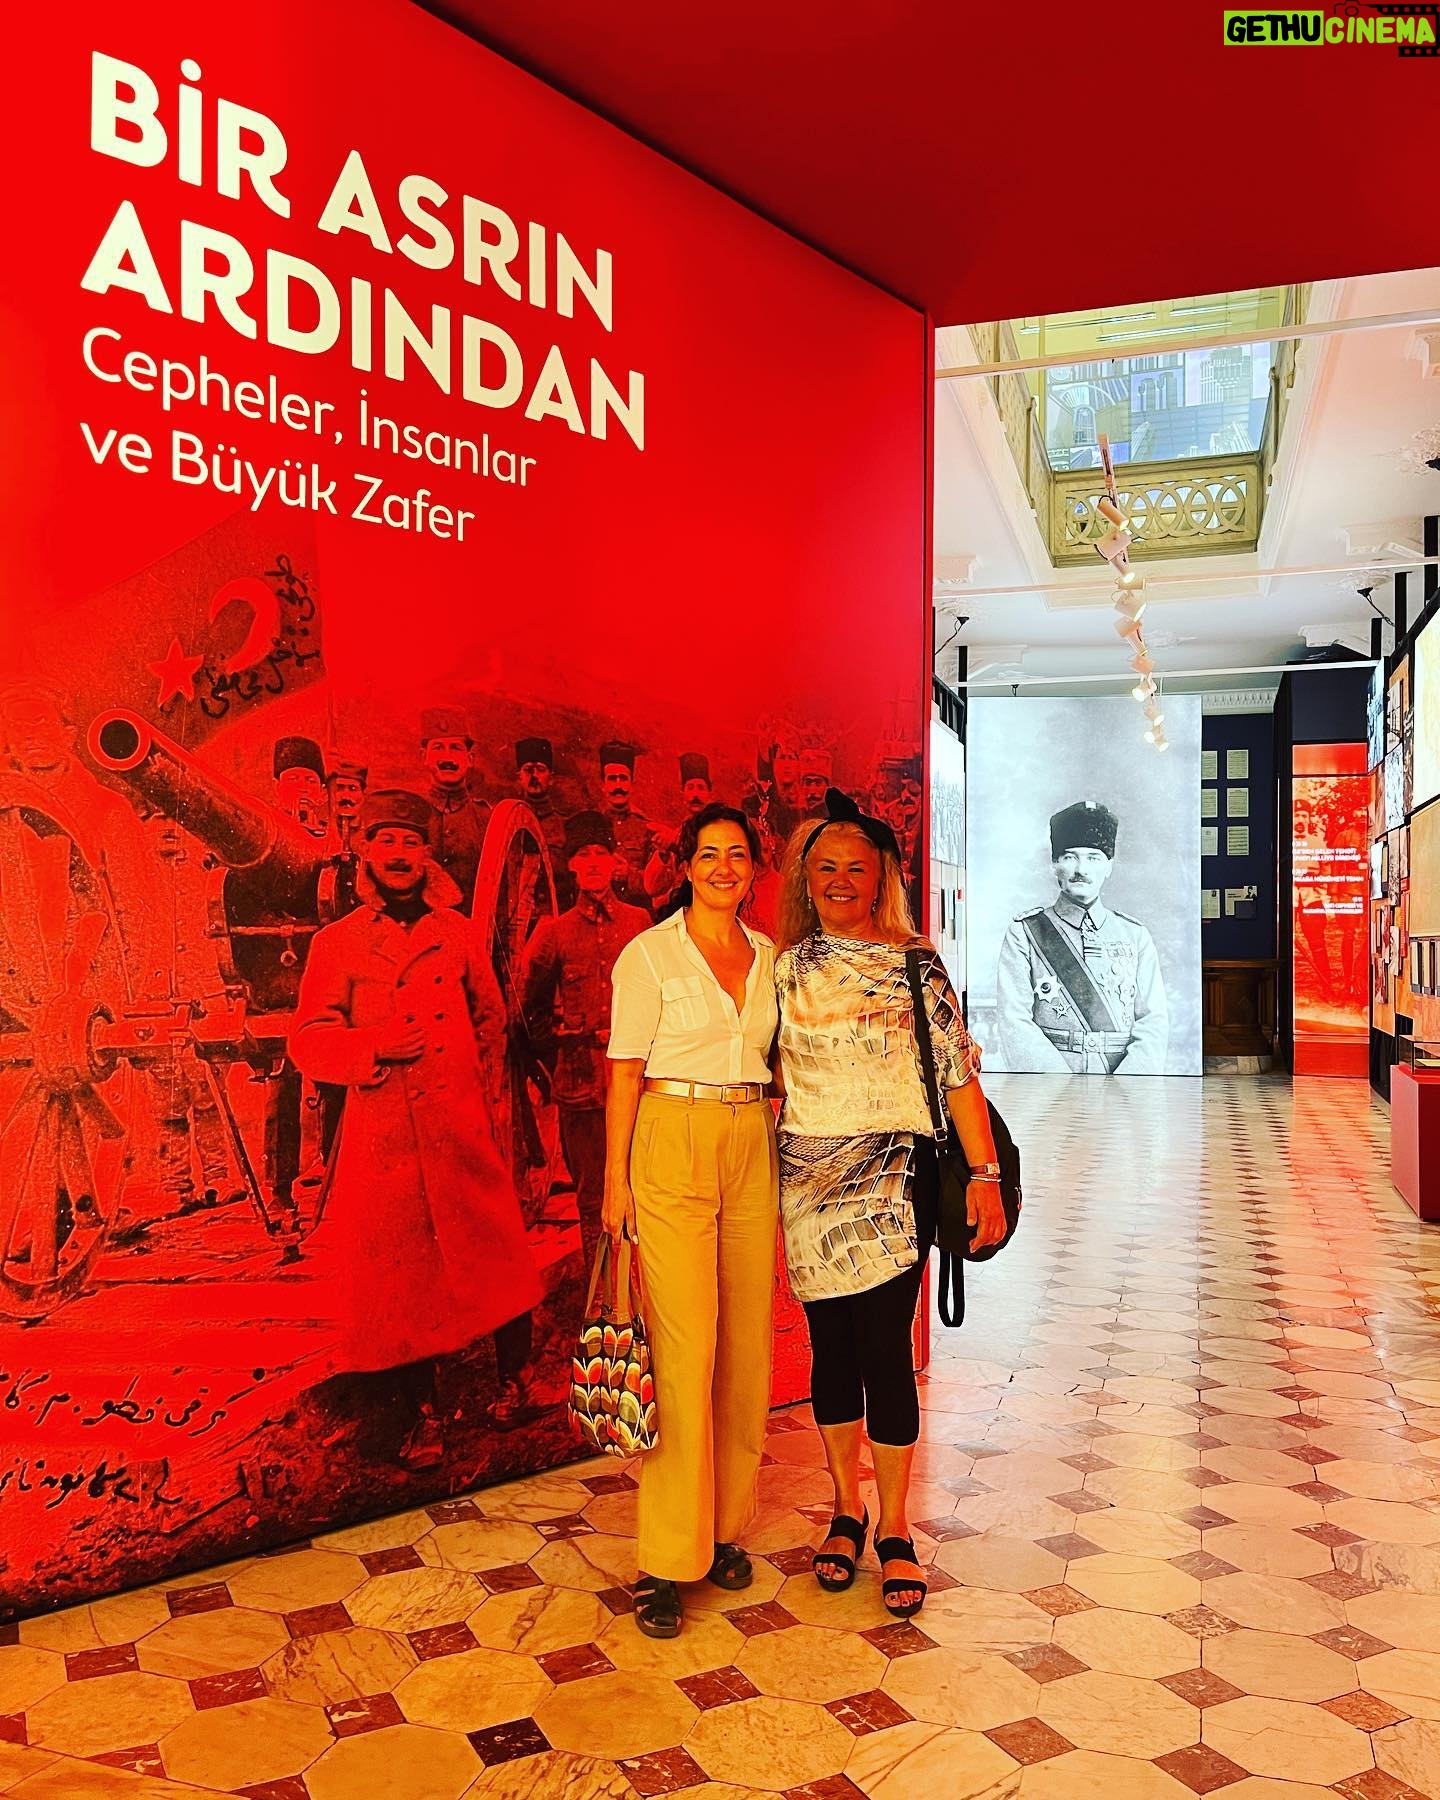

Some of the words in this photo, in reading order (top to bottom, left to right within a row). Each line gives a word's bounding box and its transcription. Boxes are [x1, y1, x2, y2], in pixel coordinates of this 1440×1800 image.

[90, 50, 291, 219] BİR
[317, 149, 613, 333] ASRIN
[79, 199, 645, 452] ARDINDAN
[82, 327, 343, 445] Cepheler,
[360, 388, 537, 487] İnsanlar
[79, 422, 153, 474] ve
[172, 429, 338, 515] Büyük
[351, 473, 476, 542] Zafer
